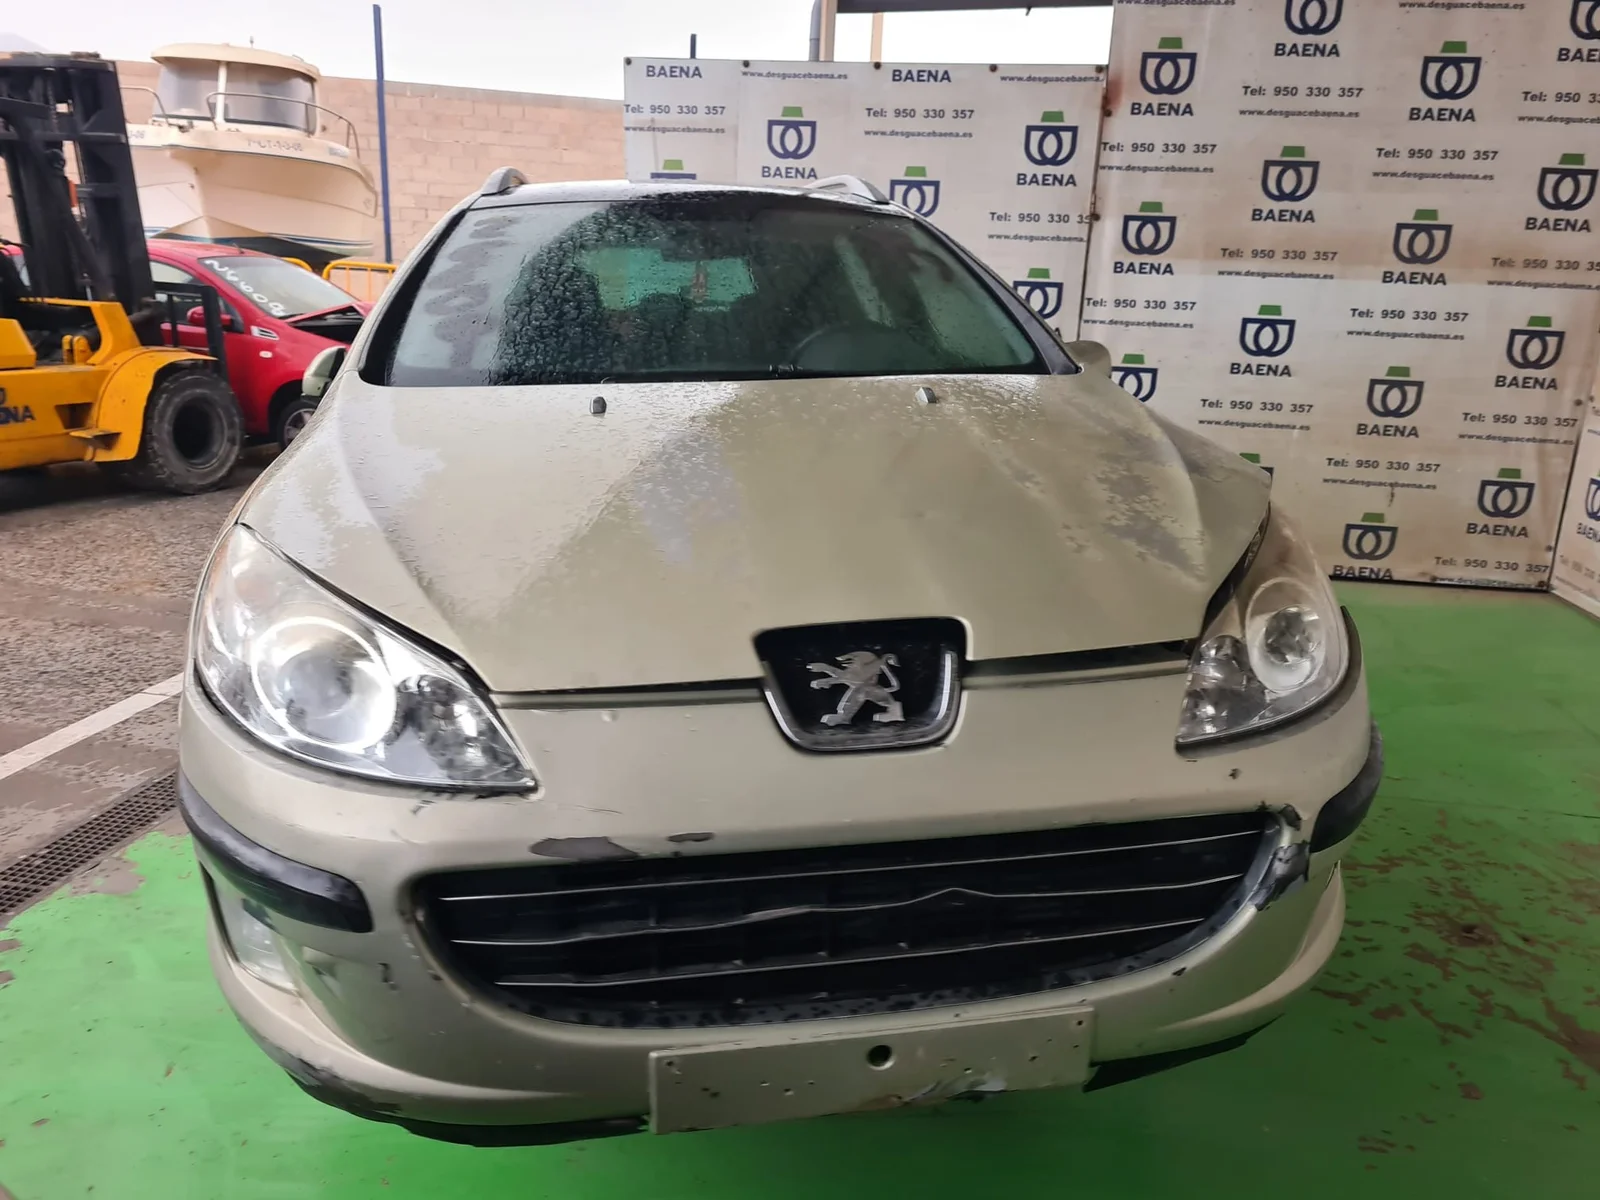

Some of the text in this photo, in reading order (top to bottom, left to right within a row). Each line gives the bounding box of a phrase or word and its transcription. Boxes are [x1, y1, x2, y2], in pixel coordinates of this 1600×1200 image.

[1399, 0, 1525, 10] www.desguacebaena.es
[1274, 43, 1340, 57] BAENA
[1557, 47, 1600, 62] BAE
[646, 65, 703, 79] BAENA
[742, 70, 848, 80] www.desguacebaena.es
[892, 69, 951, 83] BAENA
[1000, 74, 1104, 84] www.desguacebaena.
[1242, 86, 1363, 98] Tel: 950 330 357
[1522, 91, 1547, 102] Tel:
[1555, 92, 1581, 103] 950
[624, 104, 726, 115] Tel: 950 330 357
[866, 108, 975, 119] Tel: 950 330 357
[1130, 102, 1194, 116] BAENA
[1239, 108, 1360, 118] www.desguacebaena.es
[1409, 107, 1476, 122] BAENA
[1518, 115, 1600, 125] www.desguaceb
[624, 125, 726, 134] www.desguacebaena.es
[864, 129, 973, 139] www.desguacebaena.es
[1101, 142, 1217, 154] Tel: 950 330 357
[1376, 148, 1499, 161] Tel: 950 330 357
[762, 166, 817, 180] BAENA
[1099, 163, 1214, 173] www.desguacebaena.es
[1016, 173, 1077, 187] BAENA
[1372, 171, 1494, 181] www.desguacebaena.es
[989, 212, 1092, 224] Tel: 950 330 35
[1251, 209, 1315, 223] BAENA
[1525, 217, 1591, 232] BAENA
[988, 233, 1087, 243] www.desguacebaena.
[1220, 248, 1338, 261] Tel: 950 330 357
[1113, 261, 1174, 276] BAENA
[1491, 257, 1516, 268] Tel:
[1522, 258, 1548, 269] 950
[1555, 260, 1580, 270] 330
[1218, 269, 1334, 279] www.desguacebaena.es
[1381, 271, 1447, 286] BAENA
[1085, 298, 1196, 311] Tel: 950 330 357
[1350, 308, 1469, 322] Tel: 950 330 357
[1083, 318, 1194, 329] www.desguacebaena.es
[1347, 329, 1464, 340] www.desguacebaena.es
[1229, 363, 1292, 377] BAENA
[1495, 375, 1558, 390] BAENA
[1200, 399, 1314, 413] Tel: 950 330 357
[1198, 420, 1310, 431] www.desguacebaena.es
[1462, 412, 1578, 427] Tel: 950 330 357
[1356, 423, 1419, 438] BAENA
[1326, 457, 1441, 473] Tel: 950 330 357
[1466, 522, 1529, 538] BAENA
[1434, 556, 1549, 574] Tel: 950 330 357
[1332, 564, 1394, 580] BAENA
